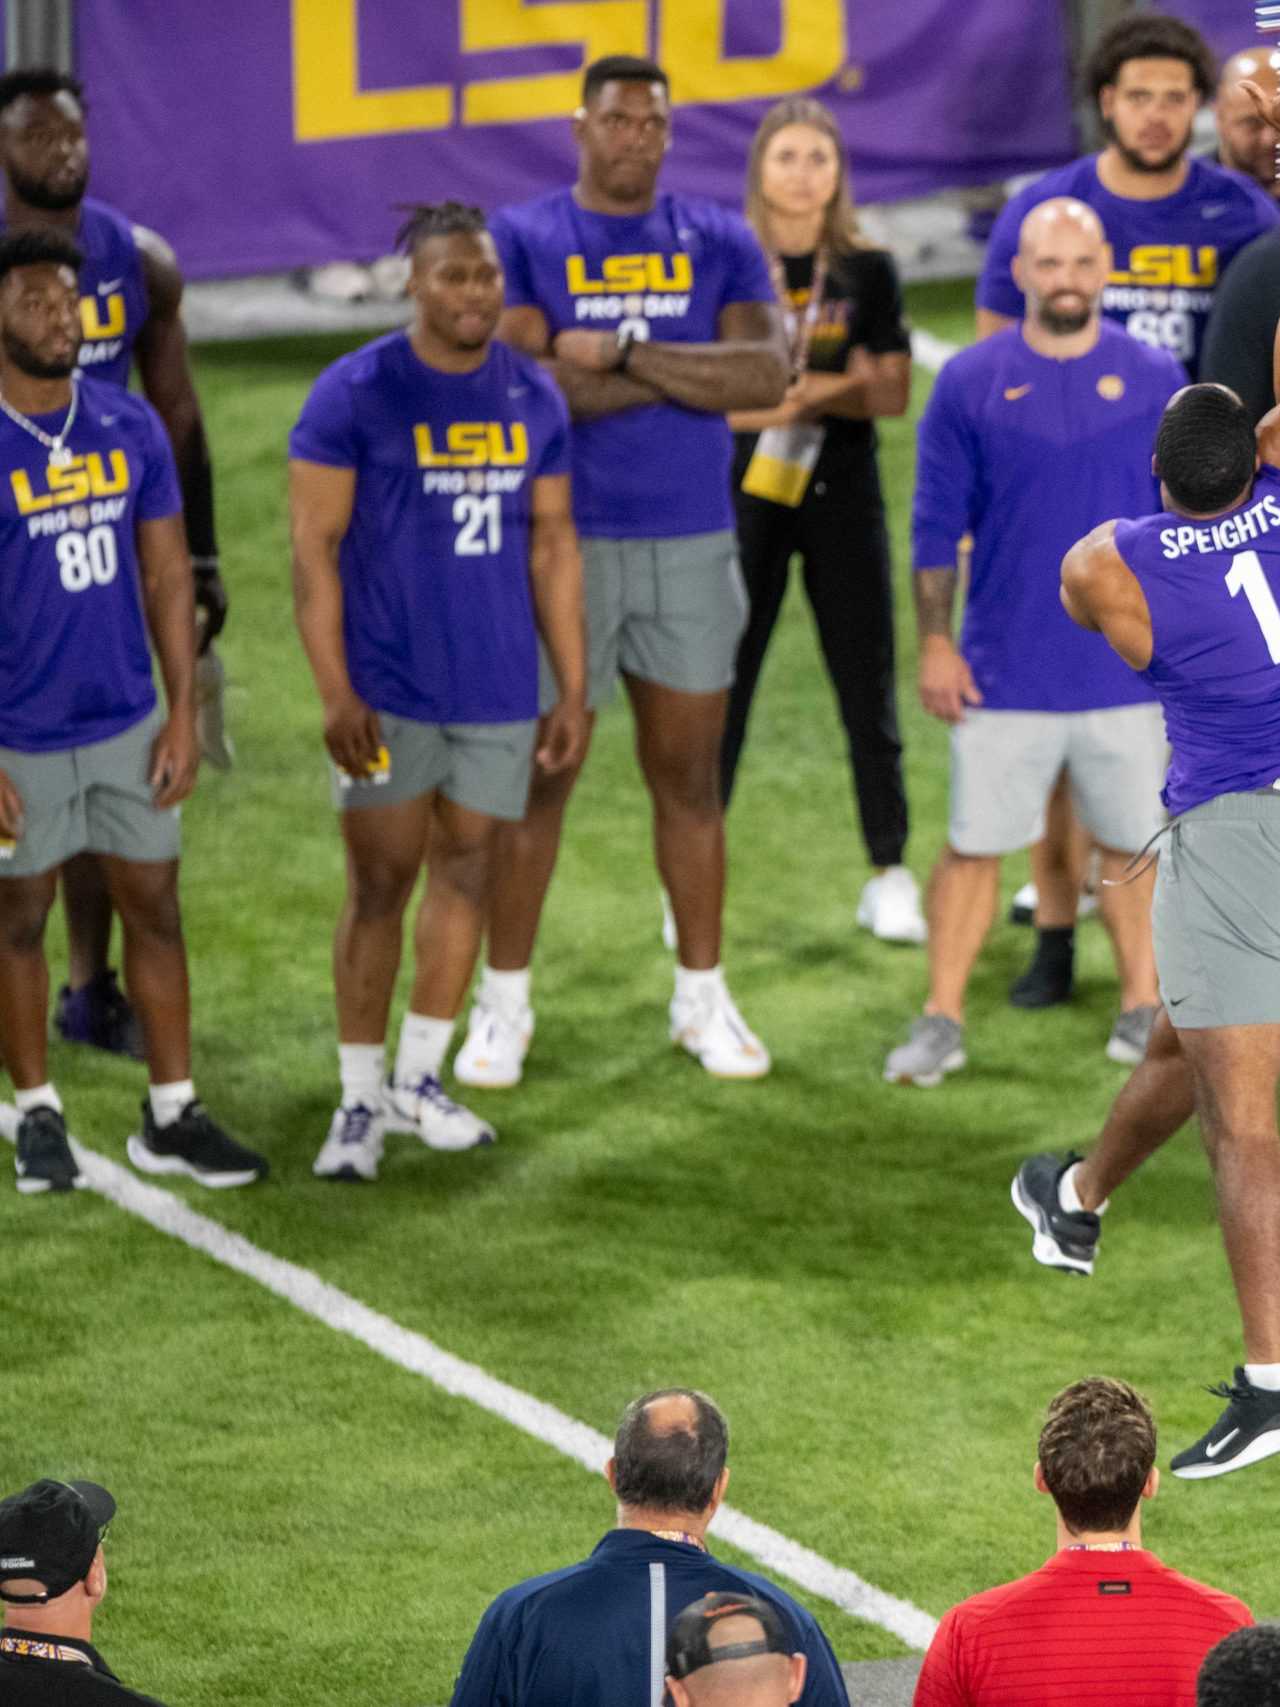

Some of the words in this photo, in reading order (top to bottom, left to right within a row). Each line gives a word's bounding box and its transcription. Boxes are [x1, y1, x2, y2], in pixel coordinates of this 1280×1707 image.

[291, 0, 846, 144] LSU
[566, 252, 692, 295] LSU
[575, 296, 619, 320] PRO
[645, 294, 690, 318] DAY
[78, 339, 122, 366] DAY
[413, 421, 528, 468] LSU
[11, 449, 130, 515] LSU
[423, 470, 465, 494] PRO
[485, 469, 525, 492] DAY
[28, 509, 68, 539] PRO
[90, 496, 127, 526] DAY
[452, 494, 502, 556] 21
[56, 524, 118, 592] 80
